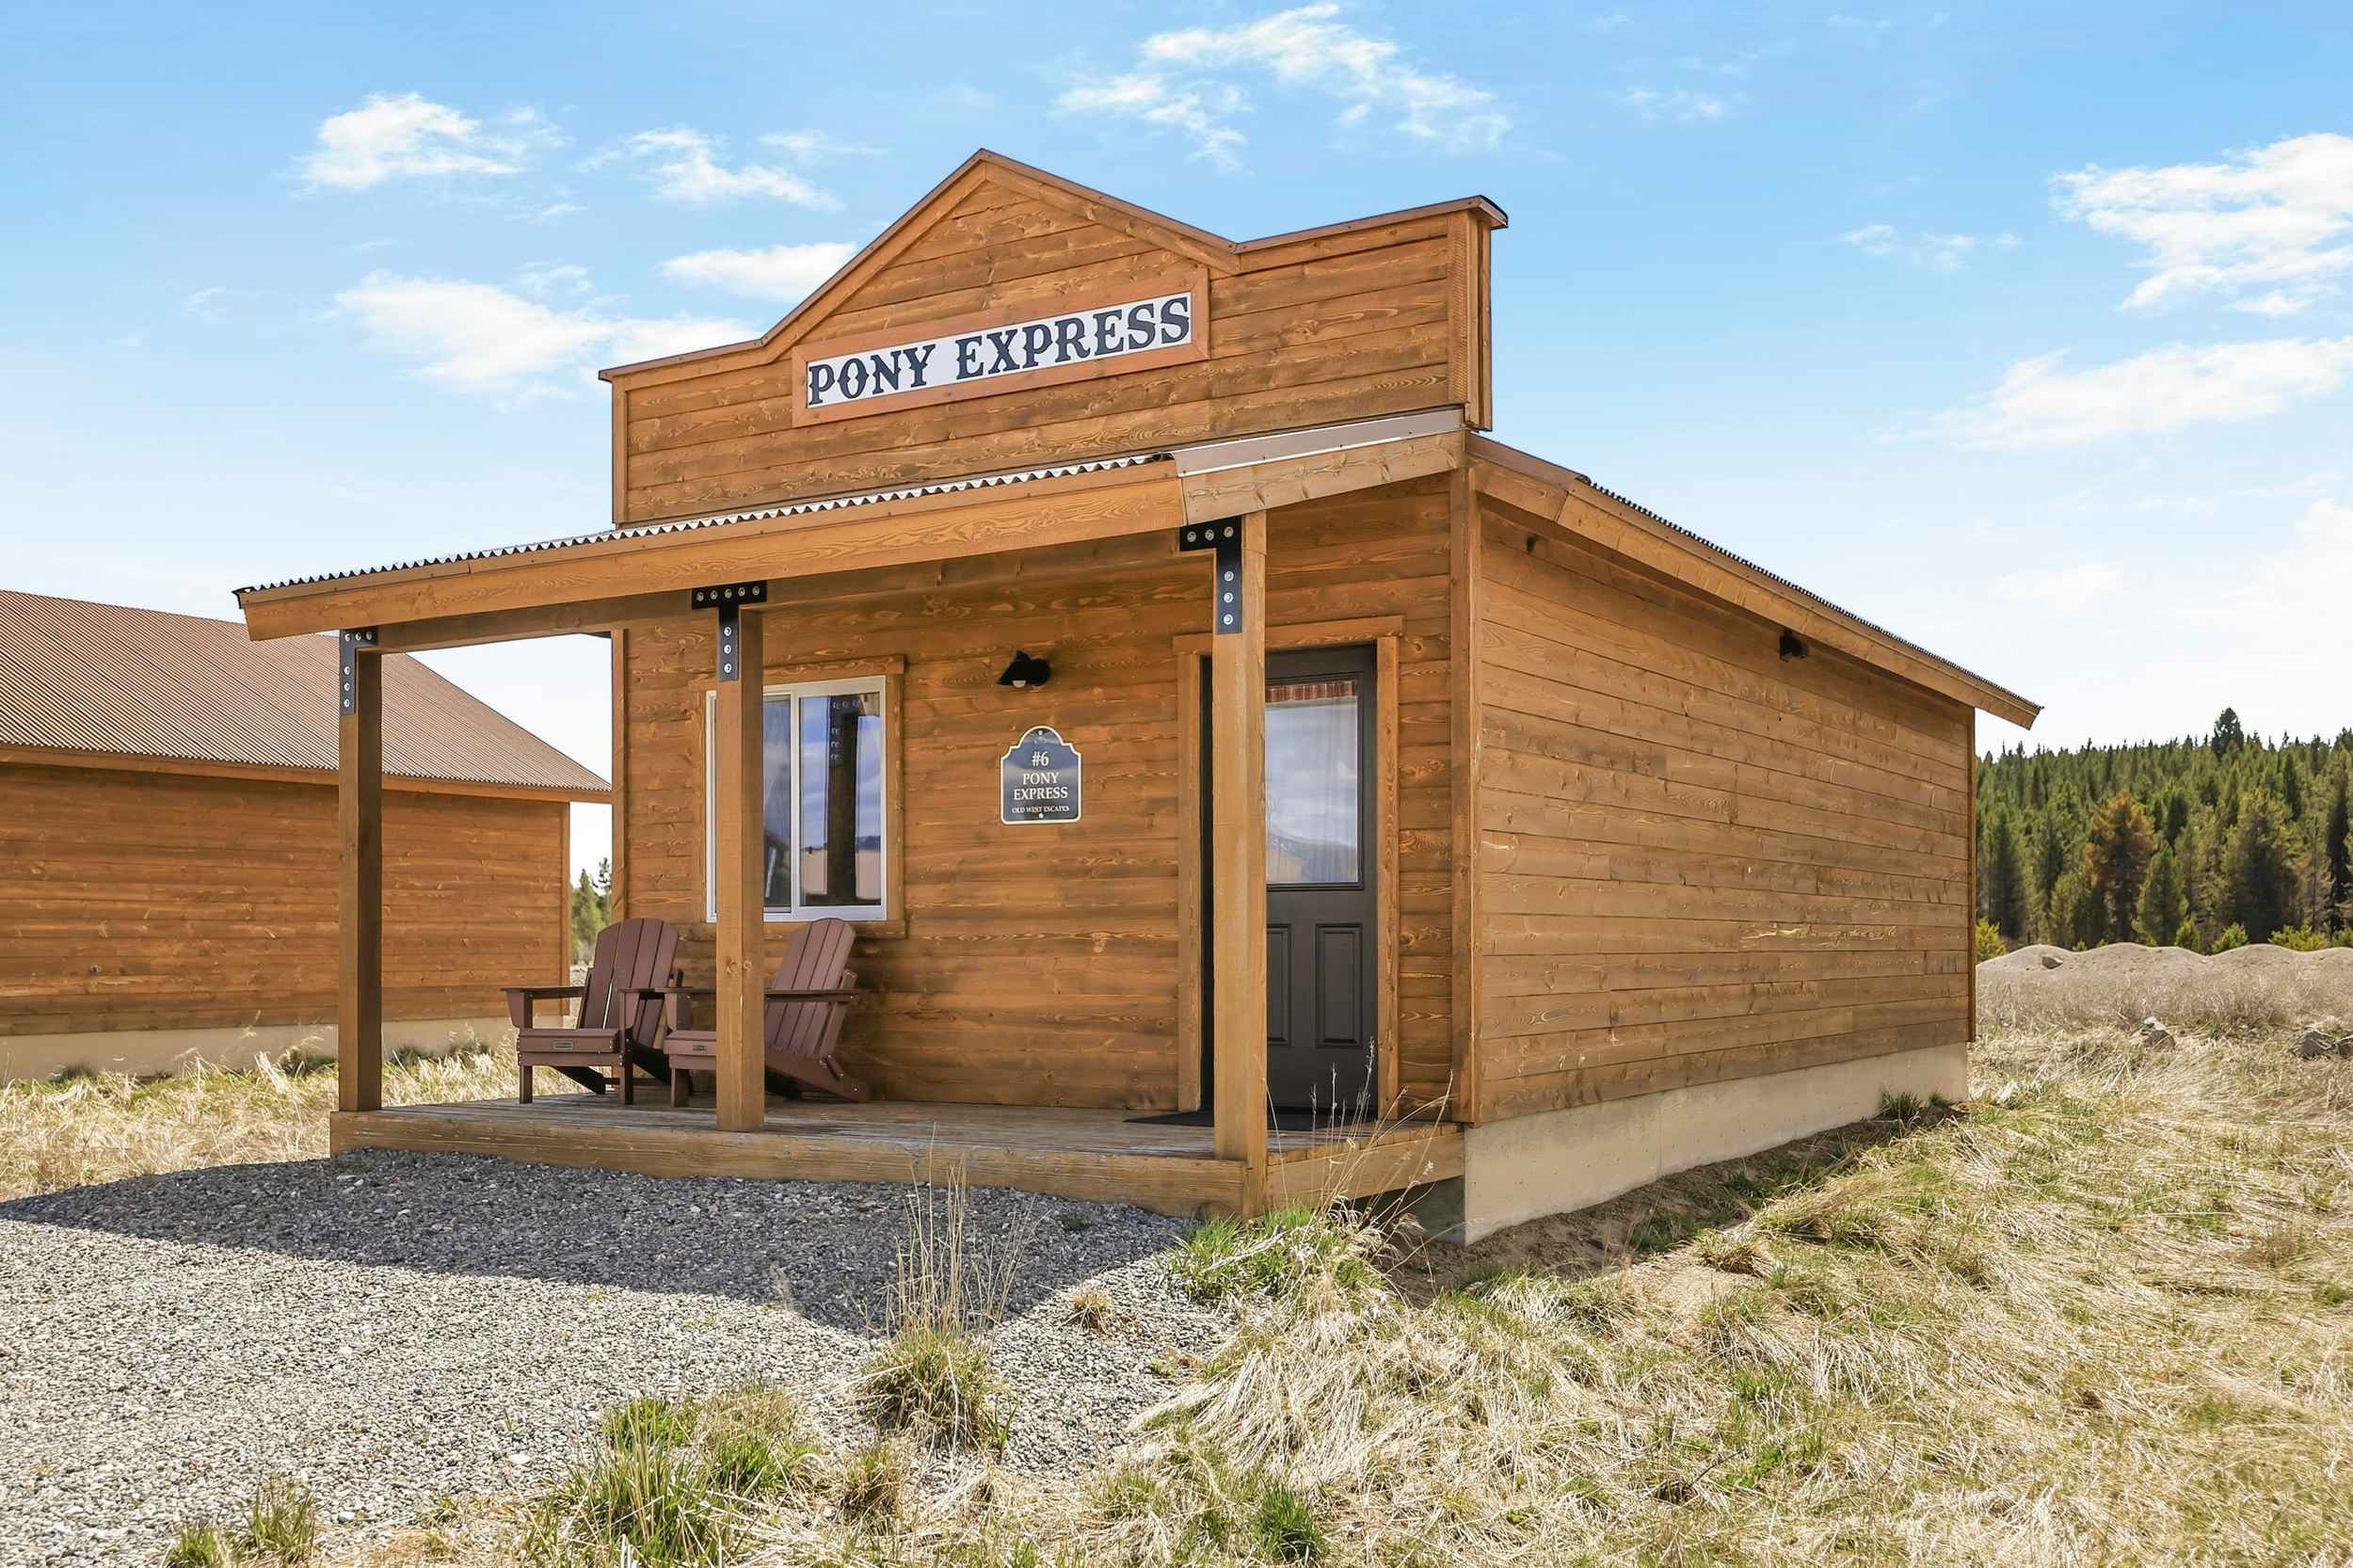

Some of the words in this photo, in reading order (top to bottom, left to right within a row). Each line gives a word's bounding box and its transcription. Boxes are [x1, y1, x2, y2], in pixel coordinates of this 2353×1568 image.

[808, 344, 936, 406] PONY
[954, 296, 1190, 380] EXPRESS
[1032, 751, 1049, 767] #6
[1023, 772, 1059, 785] PONY
[1014, 787, 1068, 800] EXPRESS
